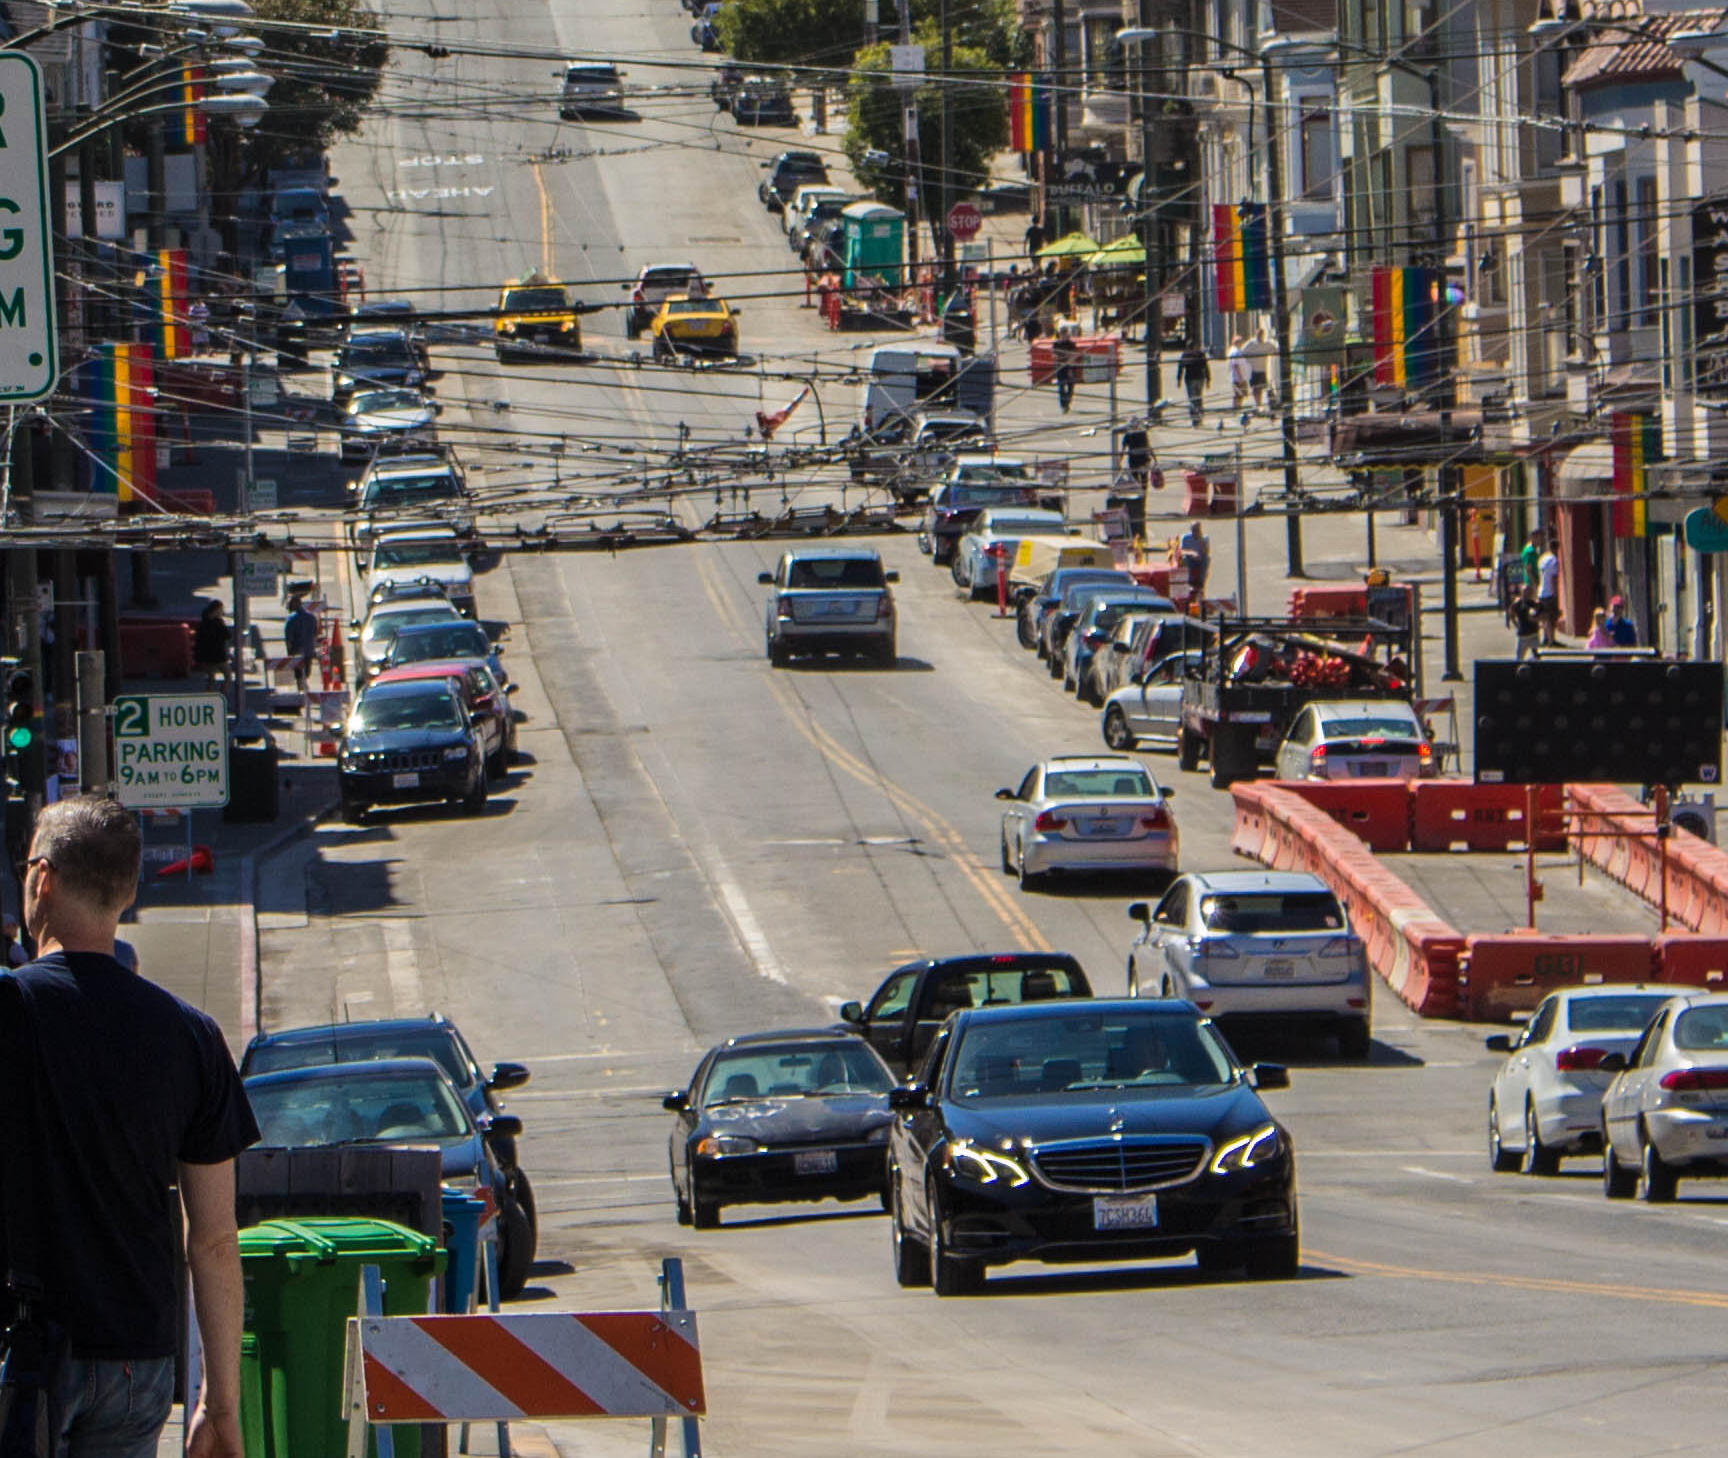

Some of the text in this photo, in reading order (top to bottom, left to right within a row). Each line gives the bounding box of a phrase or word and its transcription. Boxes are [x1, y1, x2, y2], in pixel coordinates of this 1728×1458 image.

[950, 216, 980, 230] STOP
[120, 701, 215, 734] 2 HOUR
[121, 741, 220, 764] PARKING
[120, 764, 160, 786] 9AM
[181, 763, 220, 784] 6PM
